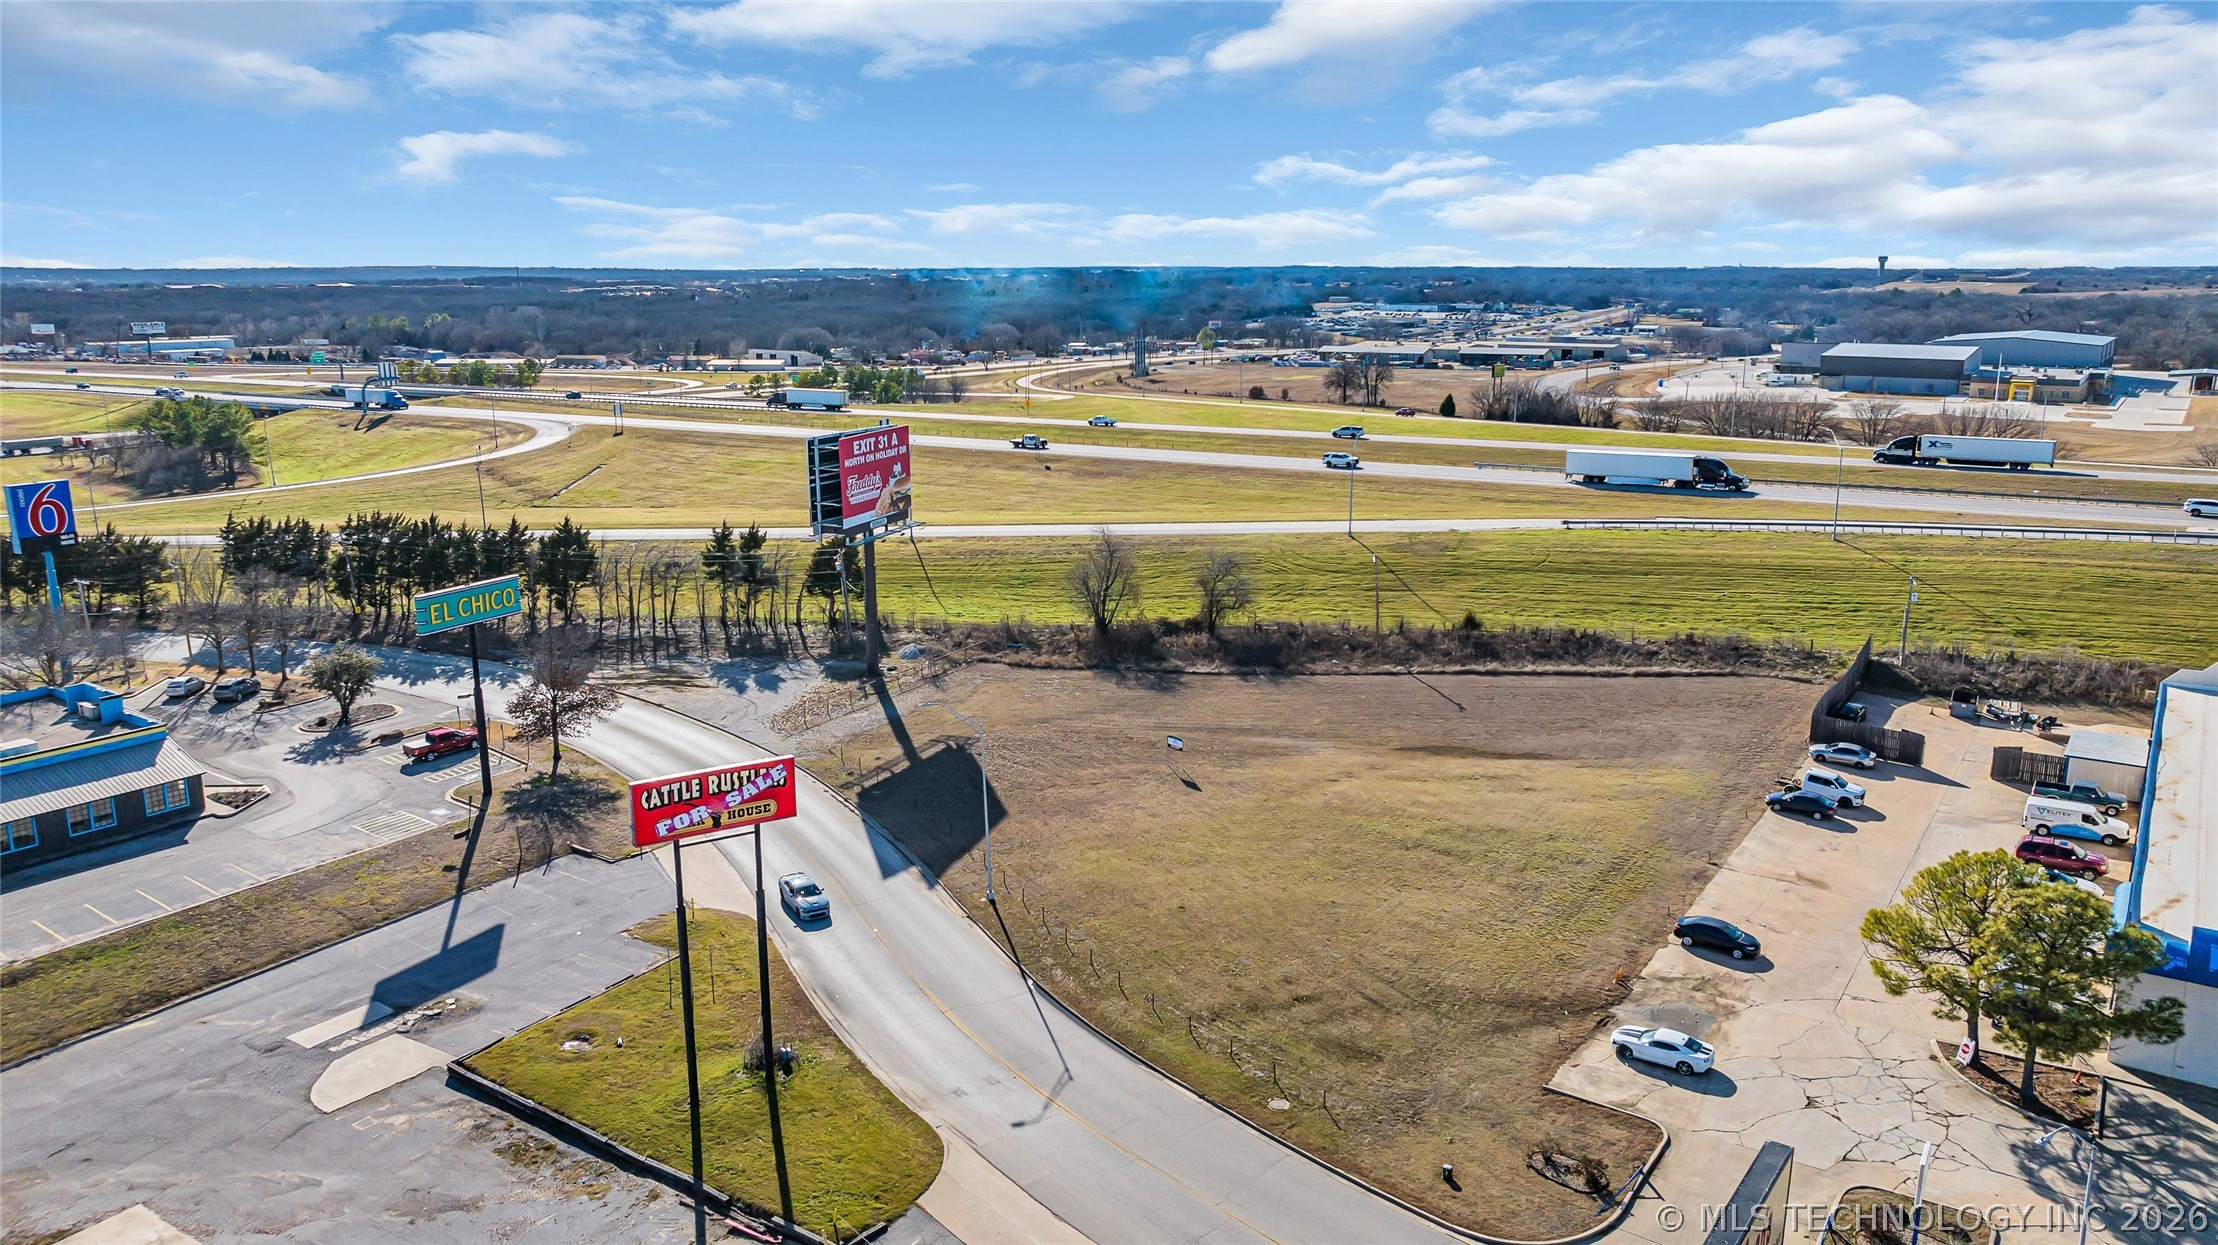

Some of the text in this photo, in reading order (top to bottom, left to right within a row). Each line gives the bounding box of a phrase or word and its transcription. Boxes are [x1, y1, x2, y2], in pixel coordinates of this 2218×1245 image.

[853, 432, 898, 454] EXIT 31 A
[844, 446, 907, 468] NORTH ON HOLIDAY DR
[846, 470, 882, 496] Freddy's
[16, 489, 26, 507] motel
[28, 483, 68, 536] 6
[429, 587, 515, 625] EL CHICO
[641, 778, 702, 810] CATTLE
[656, 805, 711, 838] FOR
[724, 763, 788, 808] SALE
[727, 802, 772, 820] HOUSE
